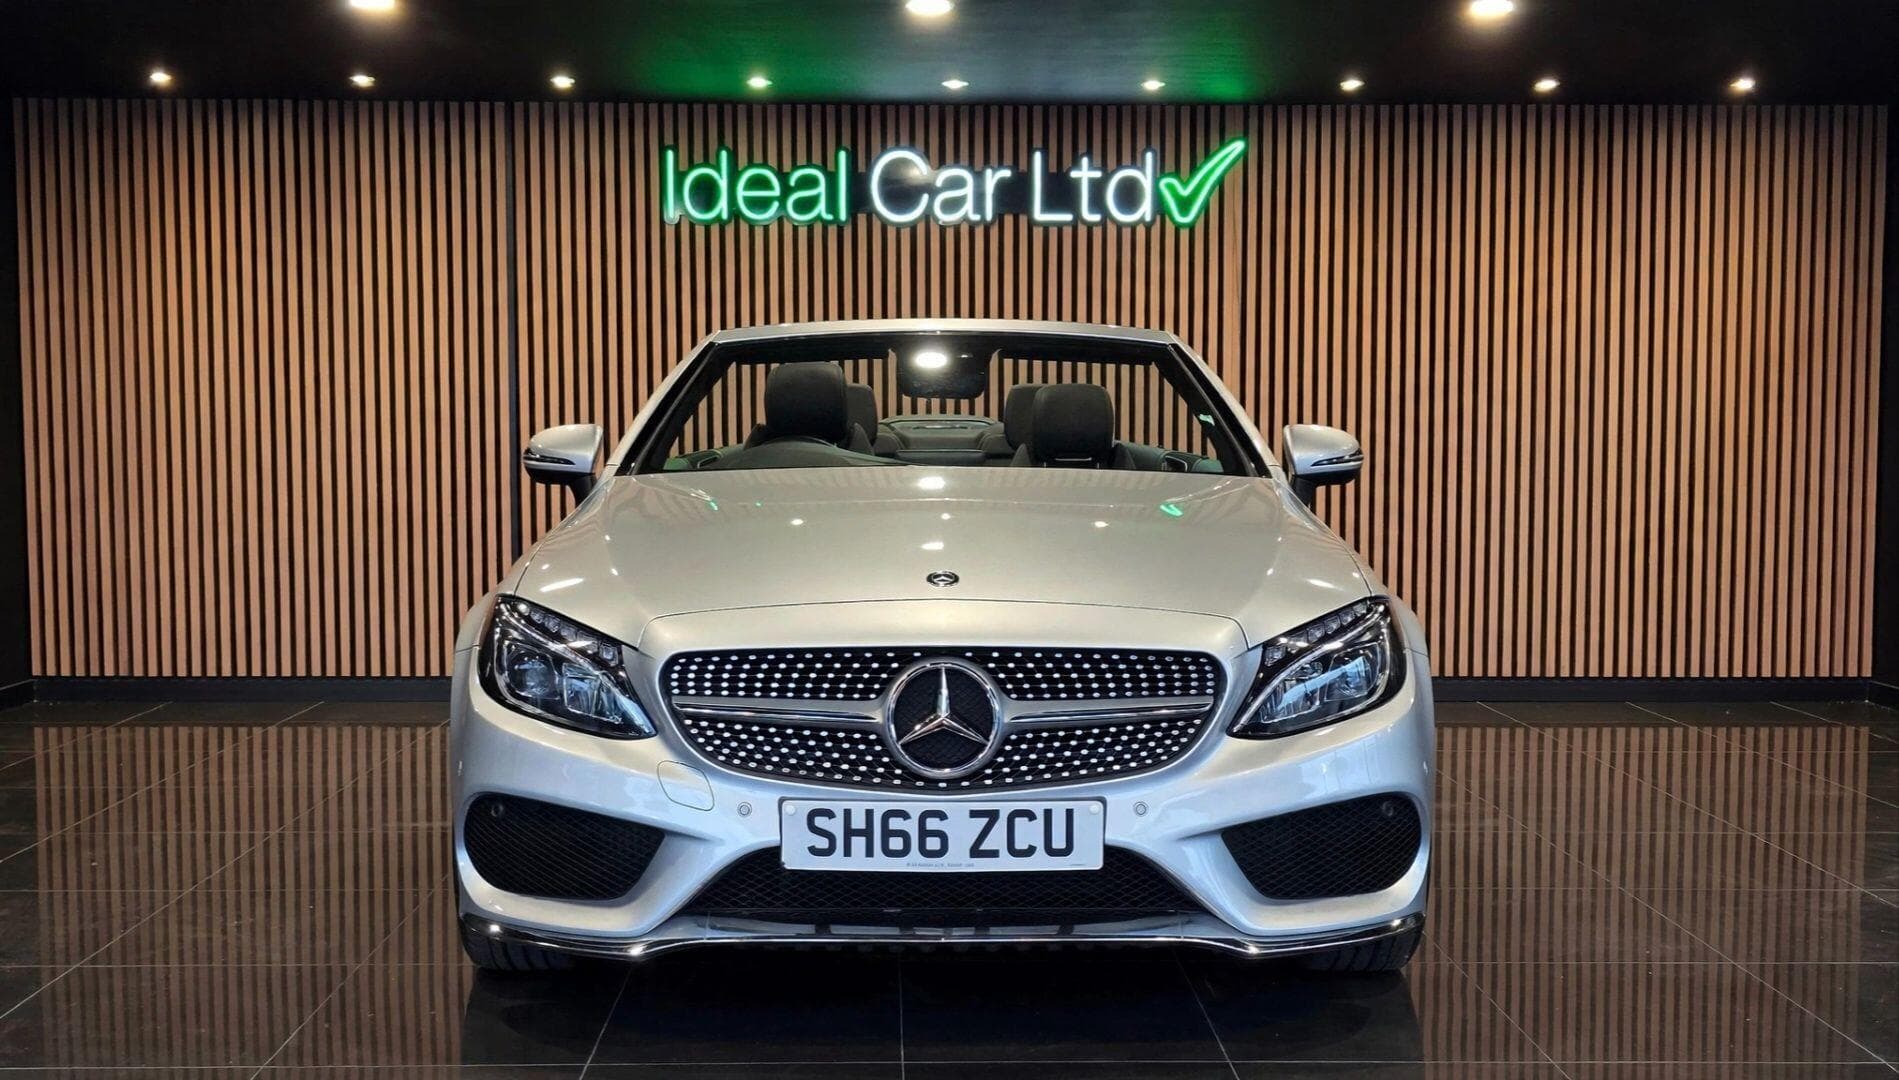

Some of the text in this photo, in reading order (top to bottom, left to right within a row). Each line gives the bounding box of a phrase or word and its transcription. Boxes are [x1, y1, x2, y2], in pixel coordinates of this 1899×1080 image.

[664, 148, 1153, 223] Ideal Car Ltd
[806, 807, 1075, 859] SH66 ZCU
